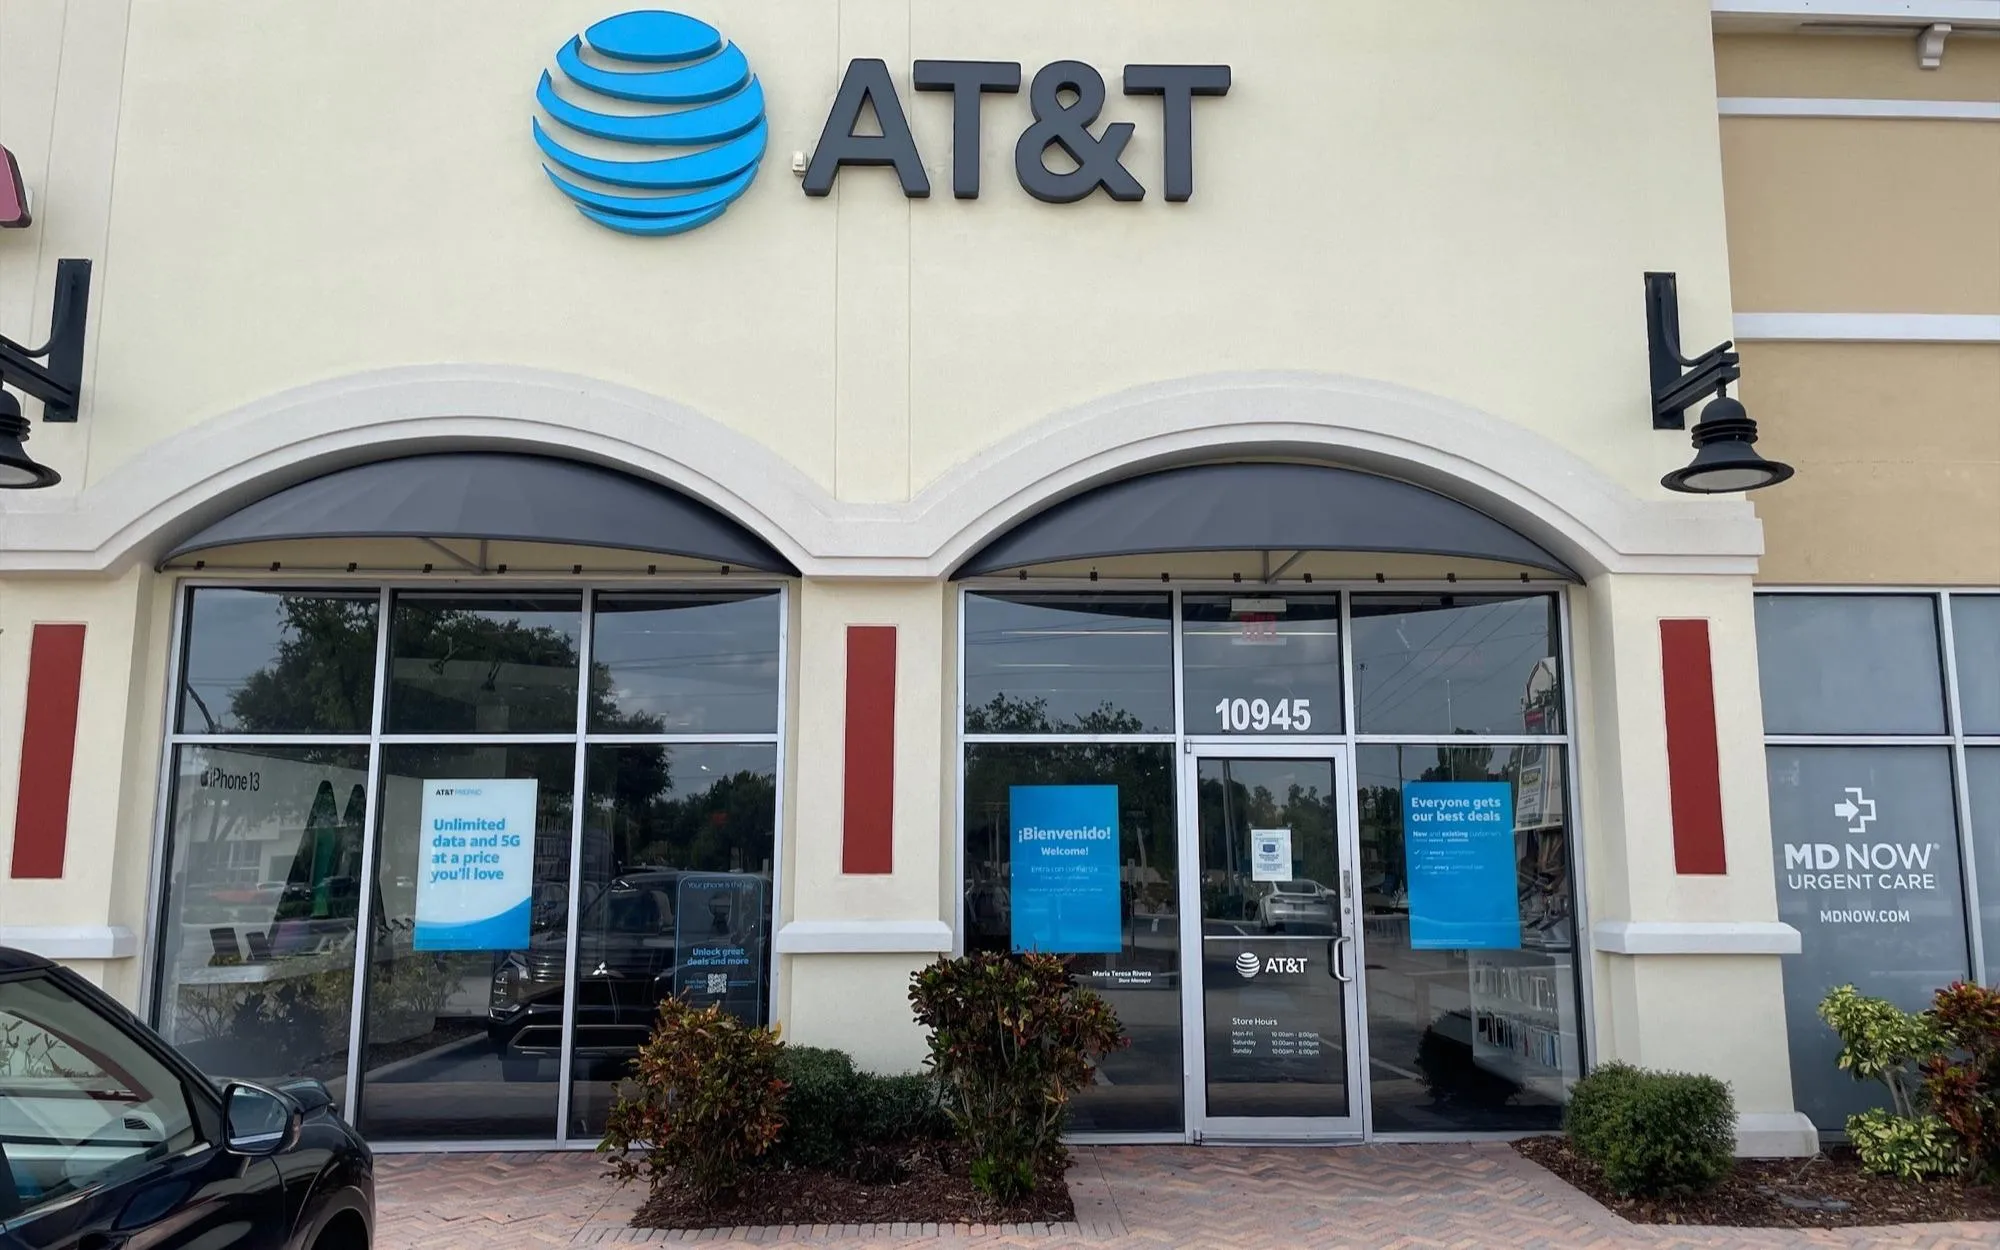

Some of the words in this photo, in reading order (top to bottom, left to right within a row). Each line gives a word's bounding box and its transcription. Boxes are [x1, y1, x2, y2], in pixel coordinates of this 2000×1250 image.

[802, 57, 1231, 203] AT&T
[1215, 697, 1311, 731] 10945
[209, 767, 247, 790] iPhone
[249, 771, 260, 792] 13
[1411, 797, 1470, 810] Everyone
[1473, 798, 1501, 810] gets
[1412, 813, 1434, 822] our
[1436, 810, 1465, 822] best
[1467, 810, 1501, 822] deals
[433, 818, 506, 831] Unlimited
[432, 835, 466, 847] data
[470, 835, 498, 847] and
[501, 835, 520, 847] 5G
[1018, 826, 1111, 843] ¡Bienvenido!
[1441, 830, 1469, 839] existing
[1041, 846, 1089, 856] Welcome!
[1784, 843, 1840, 870] MD
[432, 852, 447, 864] at
[450, 854, 459, 864] a
[463, 851, 500, 866] price
[430, 867, 470, 884] you'll
[474, 867, 504, 880] love
[1788, 874, 1873, 889] URGENT
[1878, 874, 1935, 889] CARE
[1820, 910, 1910, 923] MDNOW.COM
[692, 948, 721, 956] Unlock
[722, 949, 745, 957] great
[687, 957, 709, 966] deals
[711, 957, 726, 966] and
[1265, 958, 1308, 973] AT&T
[1232, 1017, 1253, 1026] Store
[1254, 1017, 1278, 1026] Hours
[1232, 1039, 1256, 1047] Saturday
